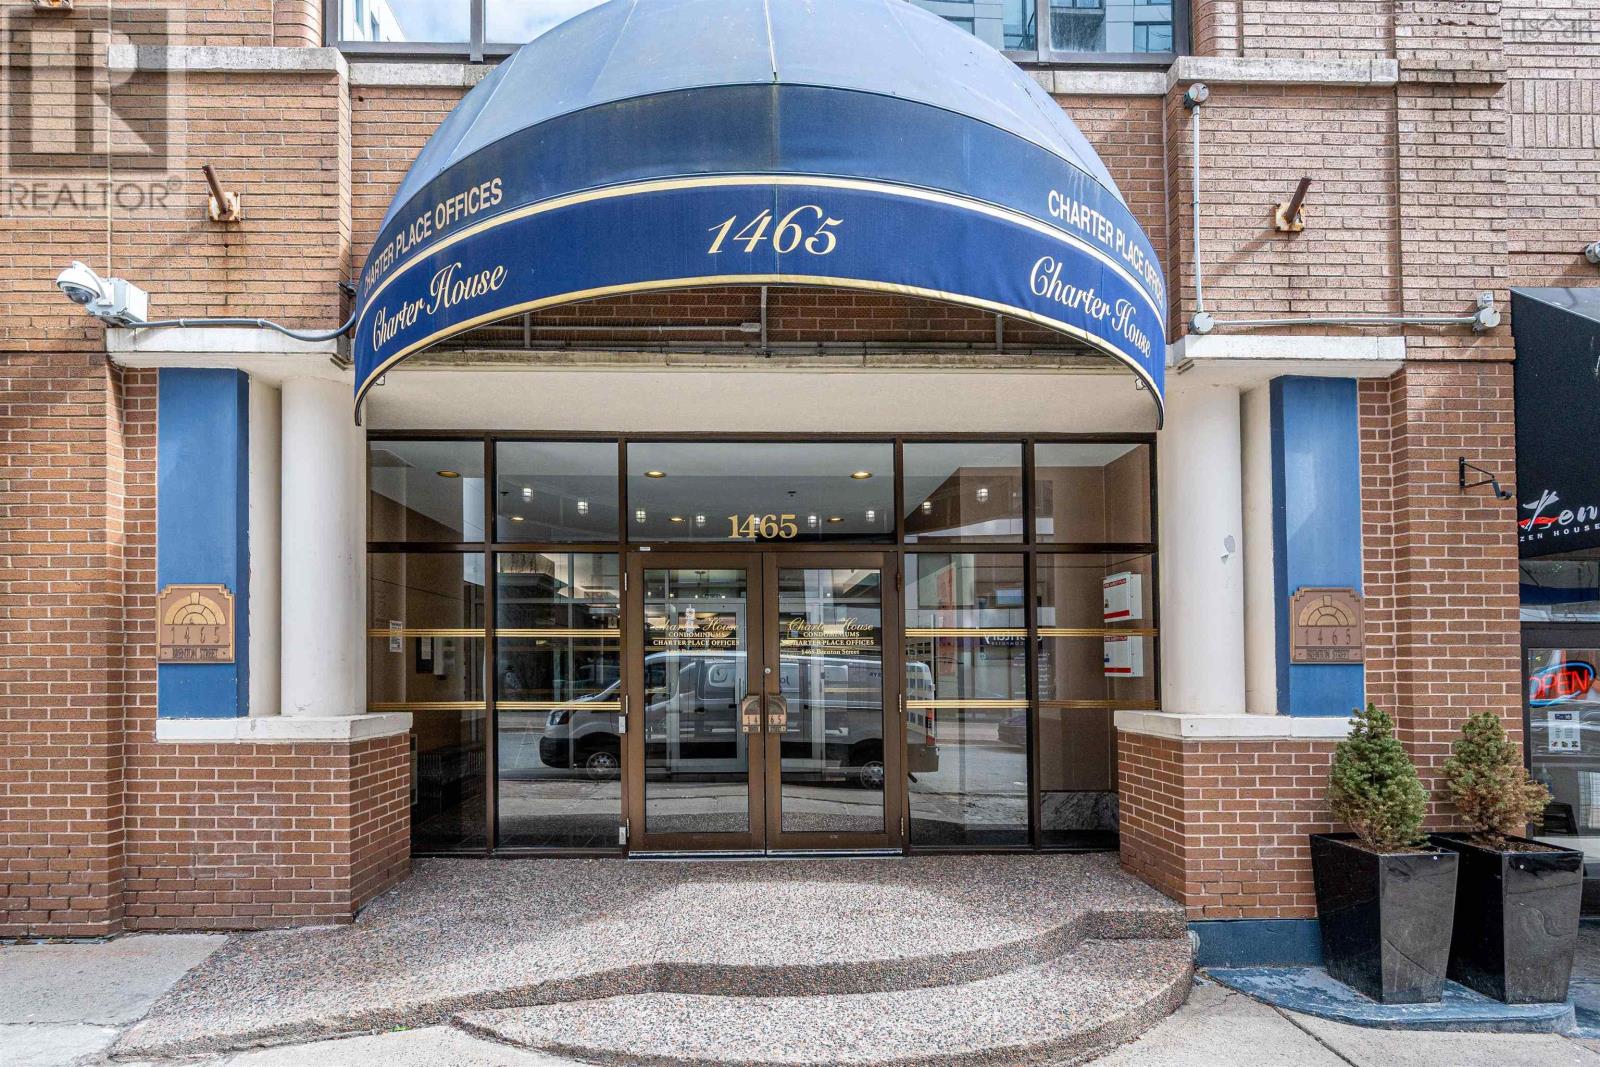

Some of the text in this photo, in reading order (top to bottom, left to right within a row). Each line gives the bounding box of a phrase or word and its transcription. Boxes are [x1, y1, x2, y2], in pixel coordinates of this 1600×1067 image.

[364, 177, 503, 298] CHARTER PLACE OFFICES
[707, 204, 844, 255] 1465
[1048, 189, 1114, 249] CHARTER
[1116, 228, 1144, 277] PLACE
[373, 262, 508, 352] Charter House
[1030, 255, 1151, 359] Charter House
[728, 514, 798, 539] 1465
[1520, 523, 1600, 542] ZEN HOUSE
[169, 626, 220, 644] 1465
[1304, 628, 1351, 645] 1465
[1529, 669, 1590, 699] OPEN
